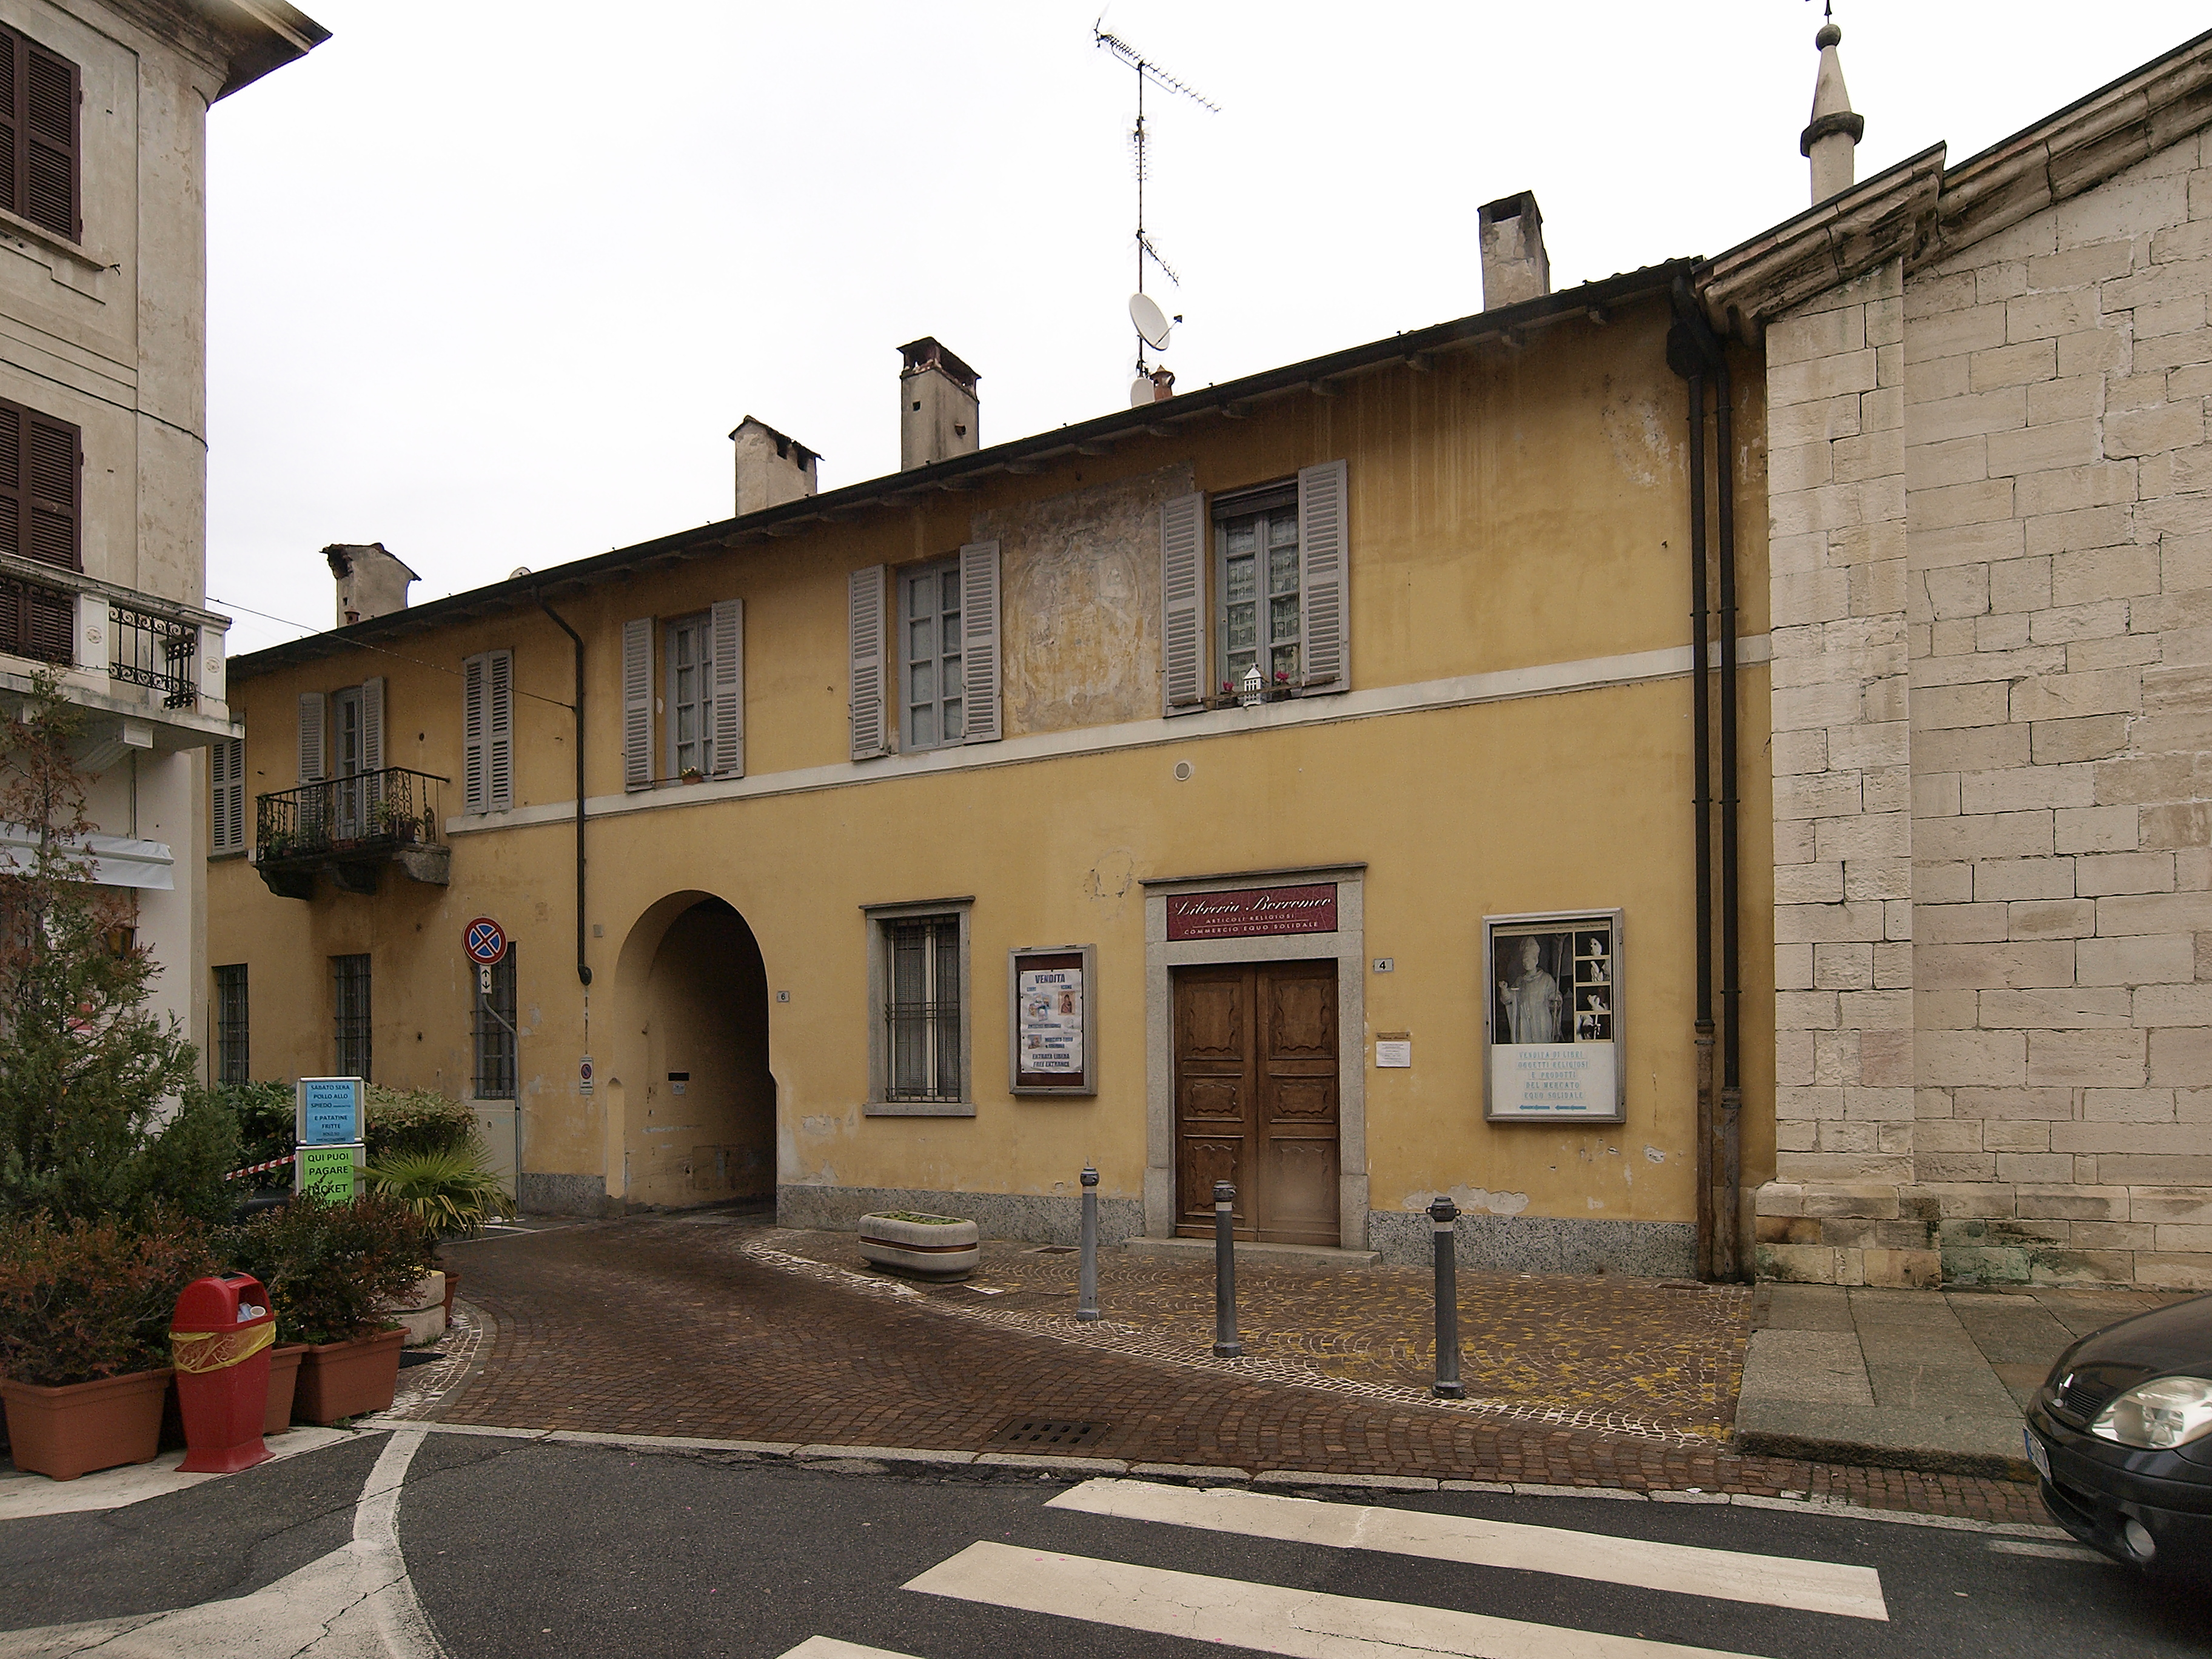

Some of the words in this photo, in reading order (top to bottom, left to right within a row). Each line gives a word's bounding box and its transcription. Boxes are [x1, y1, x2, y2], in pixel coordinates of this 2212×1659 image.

[1175, 900, 1240, 916] Libreria
[1245, 895, 1331, 911] Borromeo
[1184, 927, 1239, 935] COMMERCIO
[1273, 921, 1318, 930] SOLIDALE
[1379, 960, 1386, 970] 4
[1034, 973, 1065, 984] VENDITA
[307, 1154, 324, 1162] QUI
[309, 1165, 348, 1175] PAGARE
